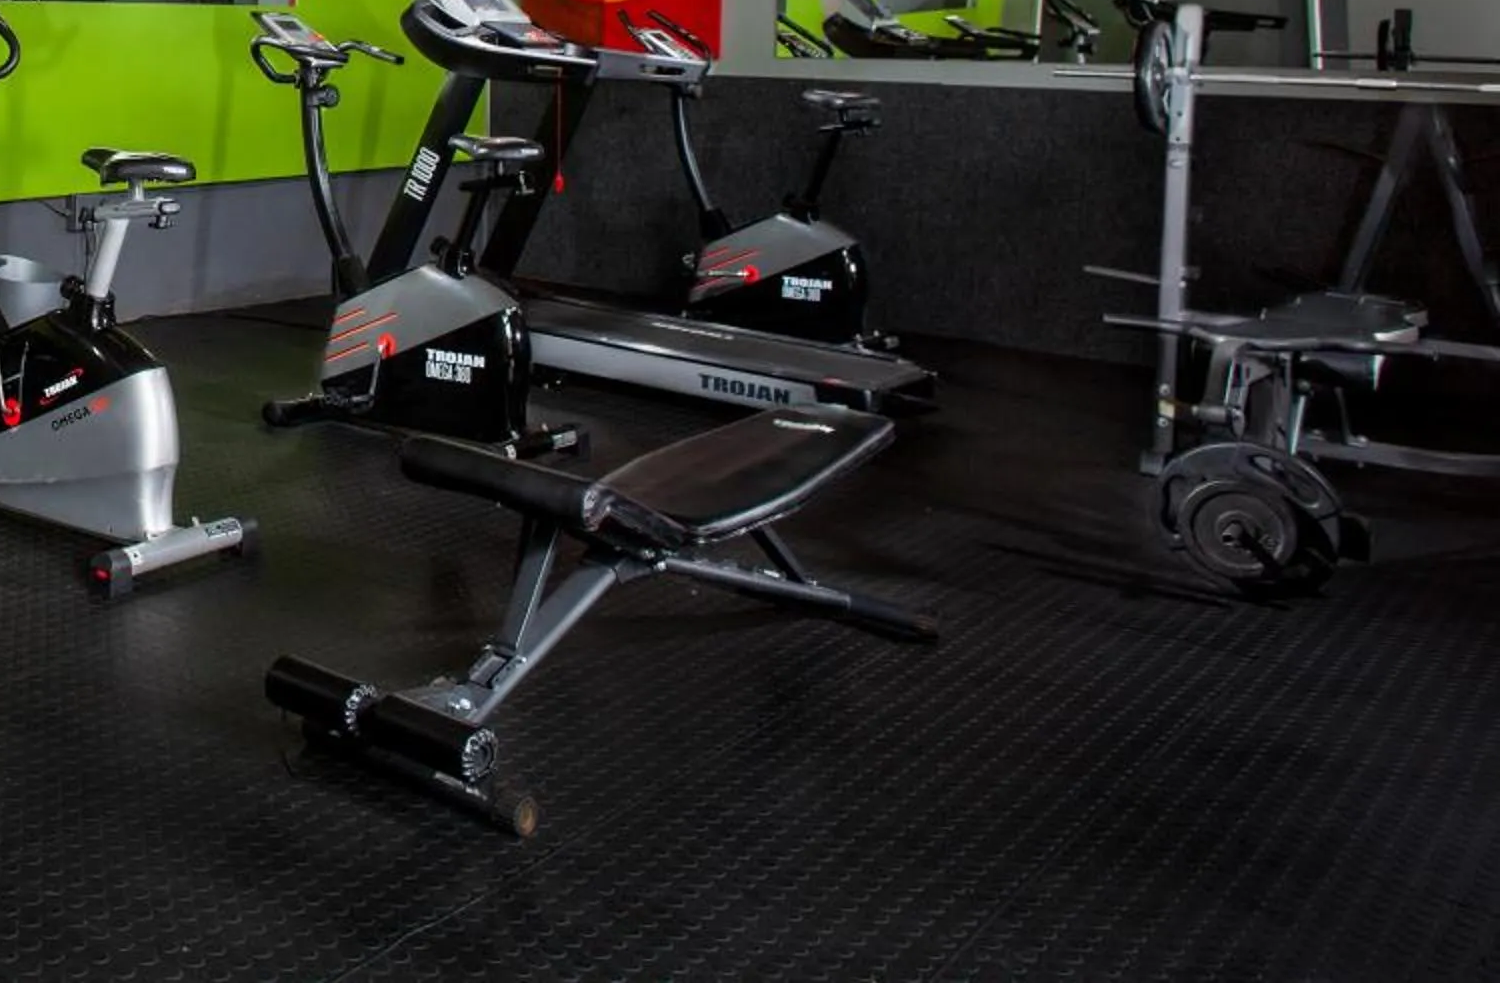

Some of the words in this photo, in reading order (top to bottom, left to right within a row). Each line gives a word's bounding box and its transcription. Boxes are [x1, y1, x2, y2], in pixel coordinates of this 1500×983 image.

[411, 146, 441, 185] 1000
[403, 178, 428, 202] TR
[781, 274, 833, 290] TROJAN
[425, 348, 486, 369] TROJAN
[425, 360, 453, 381] OMEGA
[43, 374, 79, 398] TROJAN
[698, 373, 792, 405] TROJAN
[51, 405, 92, 432] OMEGA
